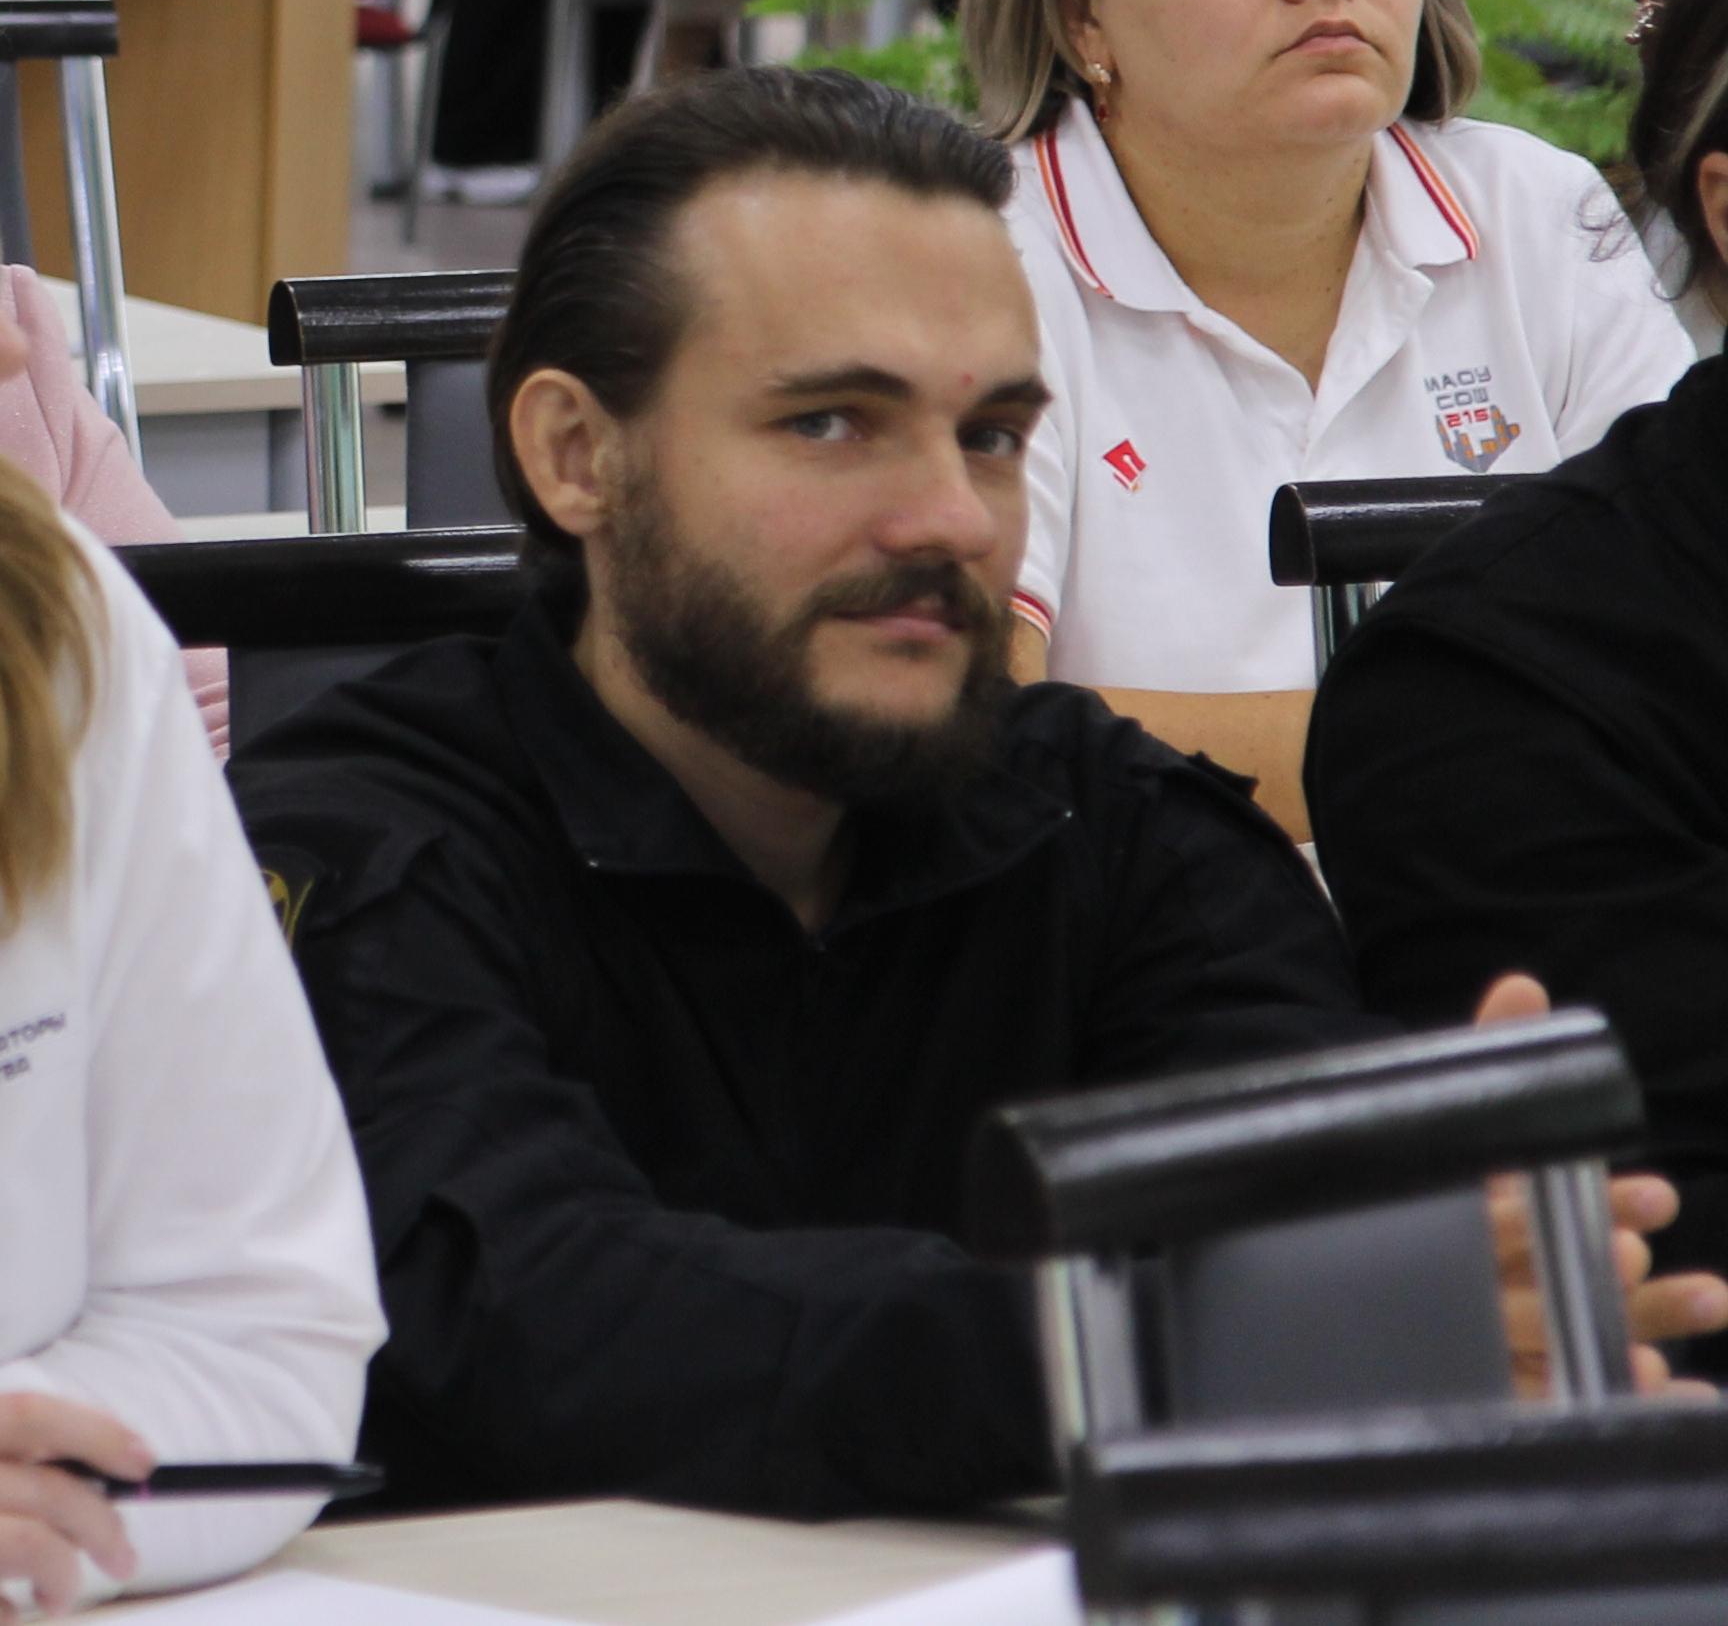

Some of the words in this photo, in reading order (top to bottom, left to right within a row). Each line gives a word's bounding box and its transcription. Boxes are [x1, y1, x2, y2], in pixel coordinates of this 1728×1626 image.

[1424, 366, 1492, 392] МАОУ
[1436, 387, 1489, 410] СОШ
[1445, 408, 1489, 428] 215
